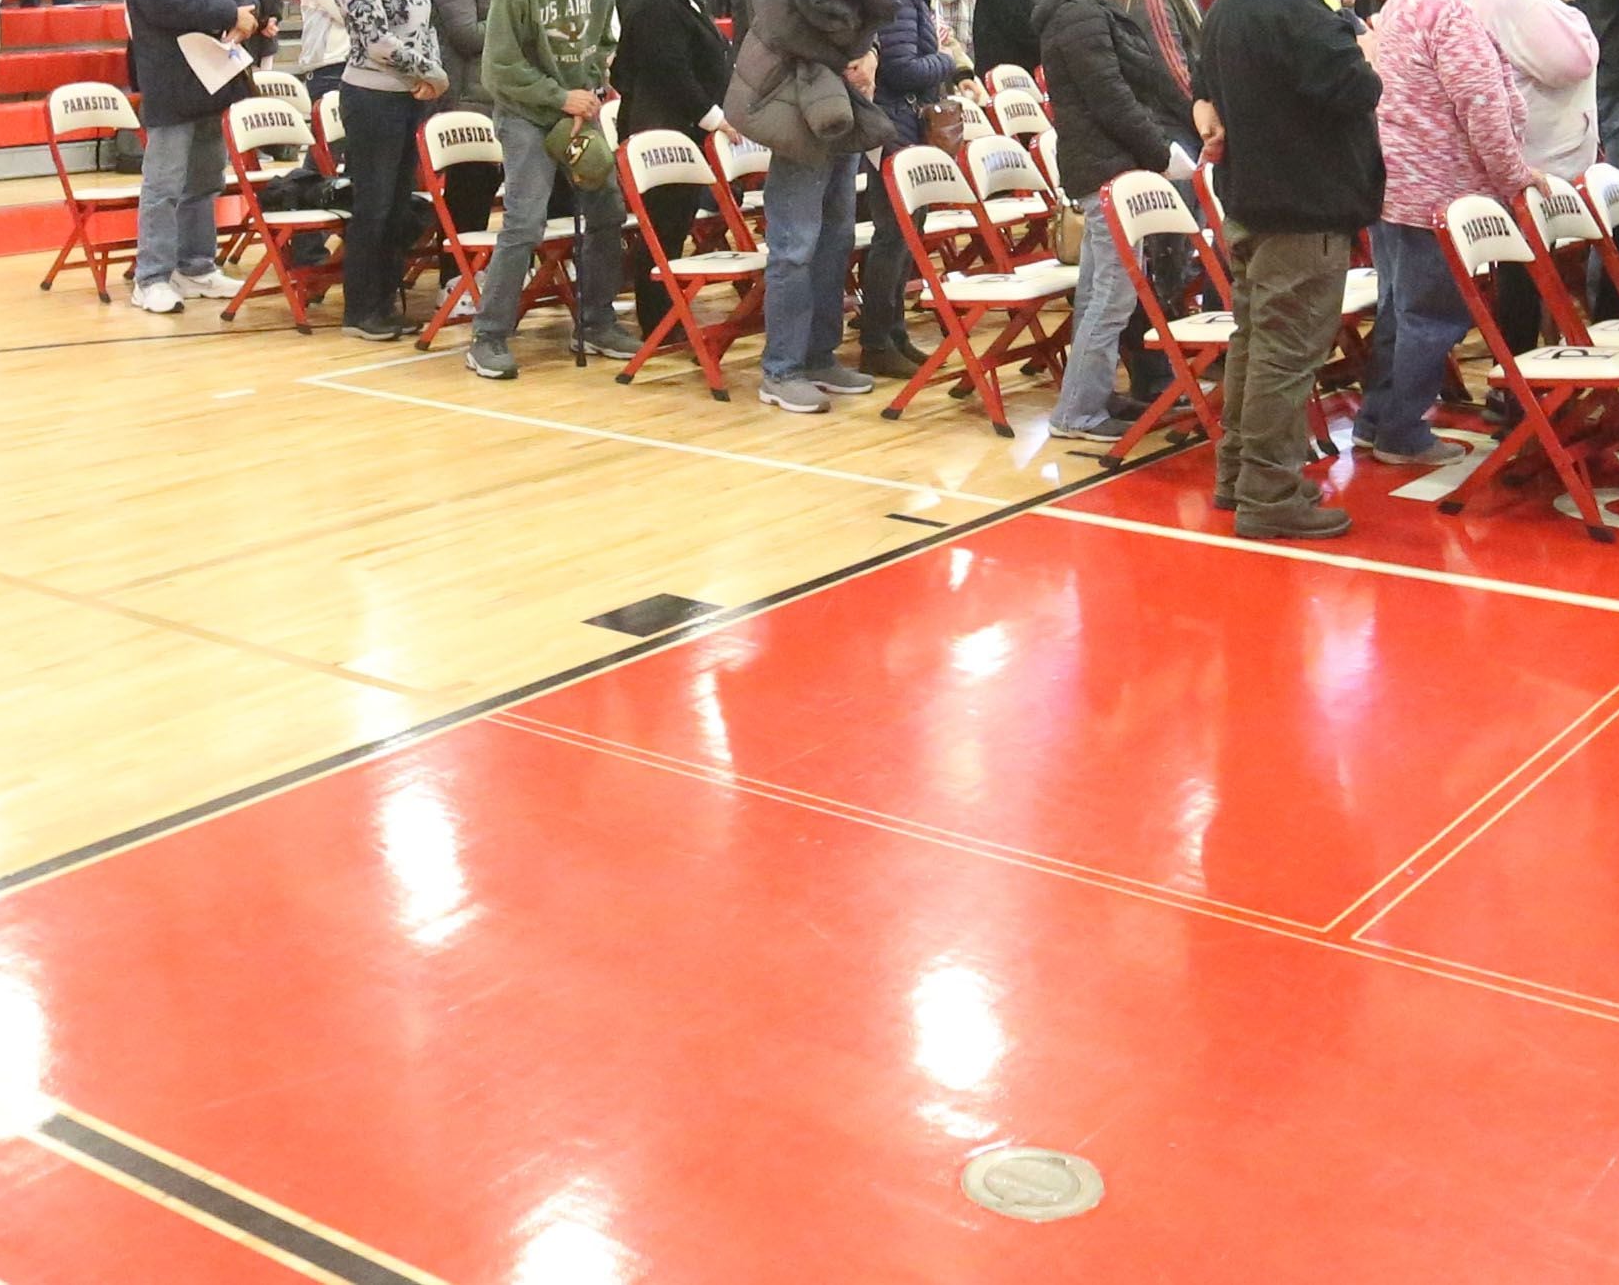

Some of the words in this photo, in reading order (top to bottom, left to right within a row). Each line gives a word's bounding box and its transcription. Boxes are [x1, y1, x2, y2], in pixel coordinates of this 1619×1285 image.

[258, 83, 298, 97] RKSIDE
[62, 96, 119, 114] PARKSIDE
[1003, 102, 1038, 121] PARKSIDE
[241, 112, 295, 131] PARKSIDE
[439, 127, 495, 149] PARKSIDE
[640, 146, 696, 169] PARKSIDE
[907, 162, 956, 188] PARKSIDE
[1126, 190, 1178, 219] PARKSIDE
[1539, 195, 1582, 223] PARKSIDE
[1462, 215, 1511, 246] PARKSIDE
